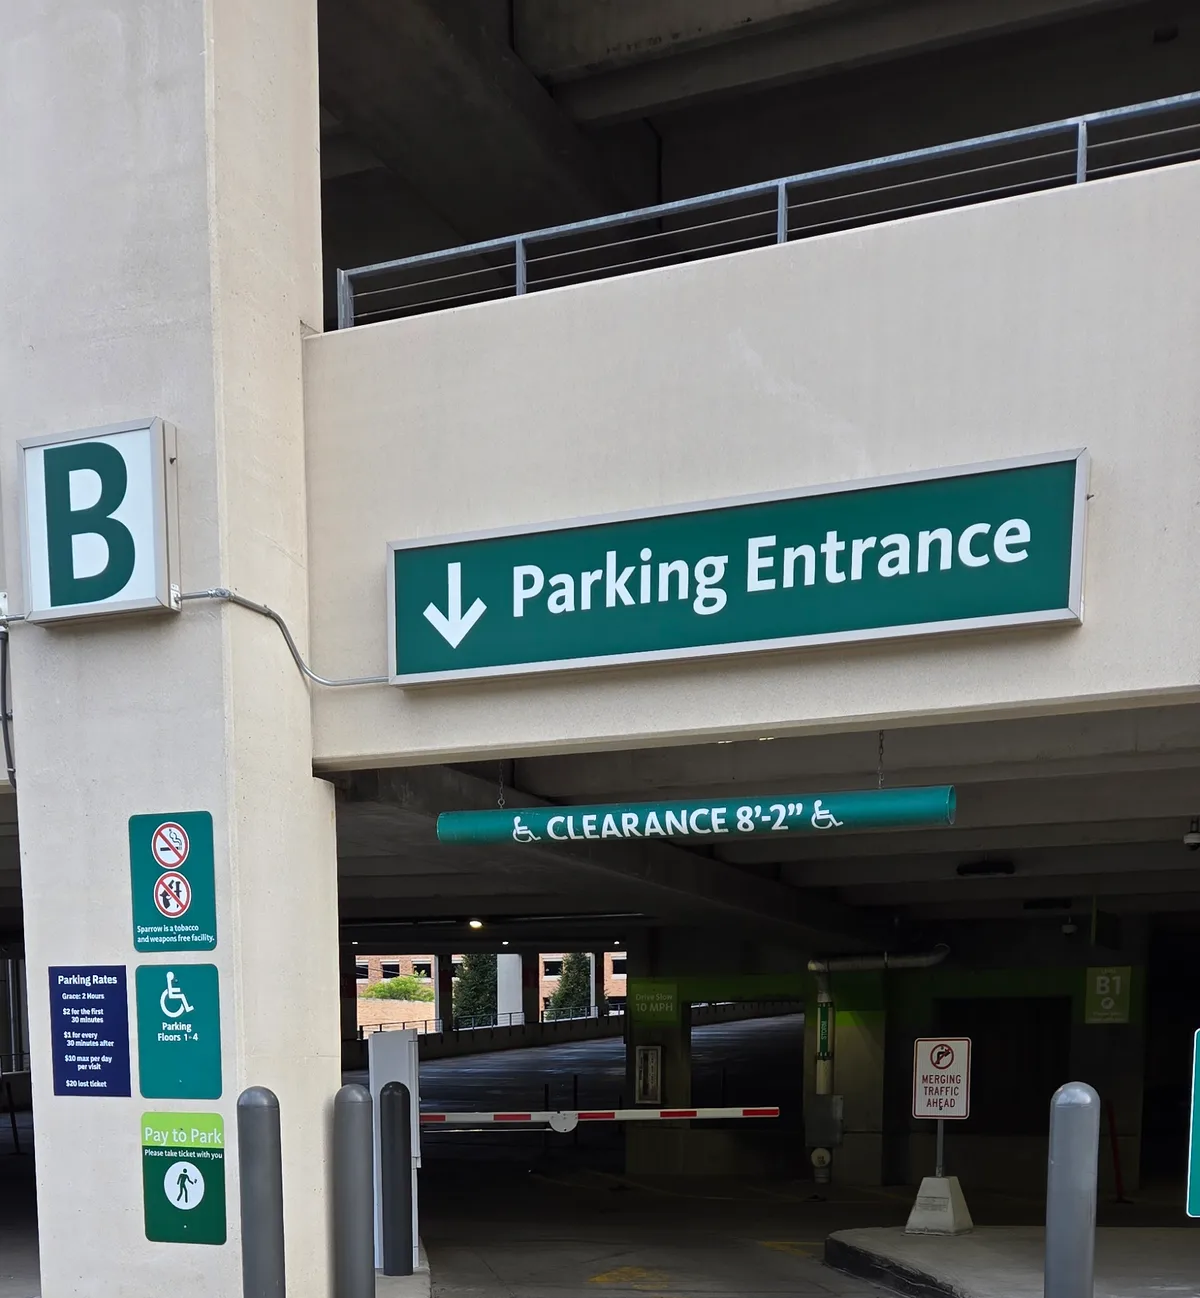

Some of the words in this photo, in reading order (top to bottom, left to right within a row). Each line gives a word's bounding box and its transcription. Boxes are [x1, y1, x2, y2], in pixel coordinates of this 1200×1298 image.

[42, 441, 137, 608] B
[512, 546, 730, 618] Parking
[746, 515, 1032, 594] Entrance
[546, 806, 729, 841] CLEARANCE
[136, 924, 163, 934] Sparrow
[174, 924, 200, 932] tobacco
[150, 936, 177, 944] weapons
[178, 934, 191, 942] free
[191, 933, 215, 943] facility.
[58, 974, 92, 986] Parking
[92, 974, 118, 984] Rates
[1096, 975, 1122, 996] B1
[656, 993, 673, 1001] Slow
[62, 1007, 70, 1015] $2
[636, 1002, 647, 1012] 10
[649, 1002, 673, 1012] MPH
[162, 1022, 192, 1033] Parking
[157, 1032, 181, 1042] Floors
[101, 1055, 112, 1064] day
[922, 1074, 962, 1084] MERGING
[924, 1086, 959, 1096] TRAFFIC
[926, 1098, 956, 1108] AHEAD
[144, 1126, 169, 1146] Pay
[172, 1128, 187, 1143] to
[191, 1128, 222, 1144] Park
